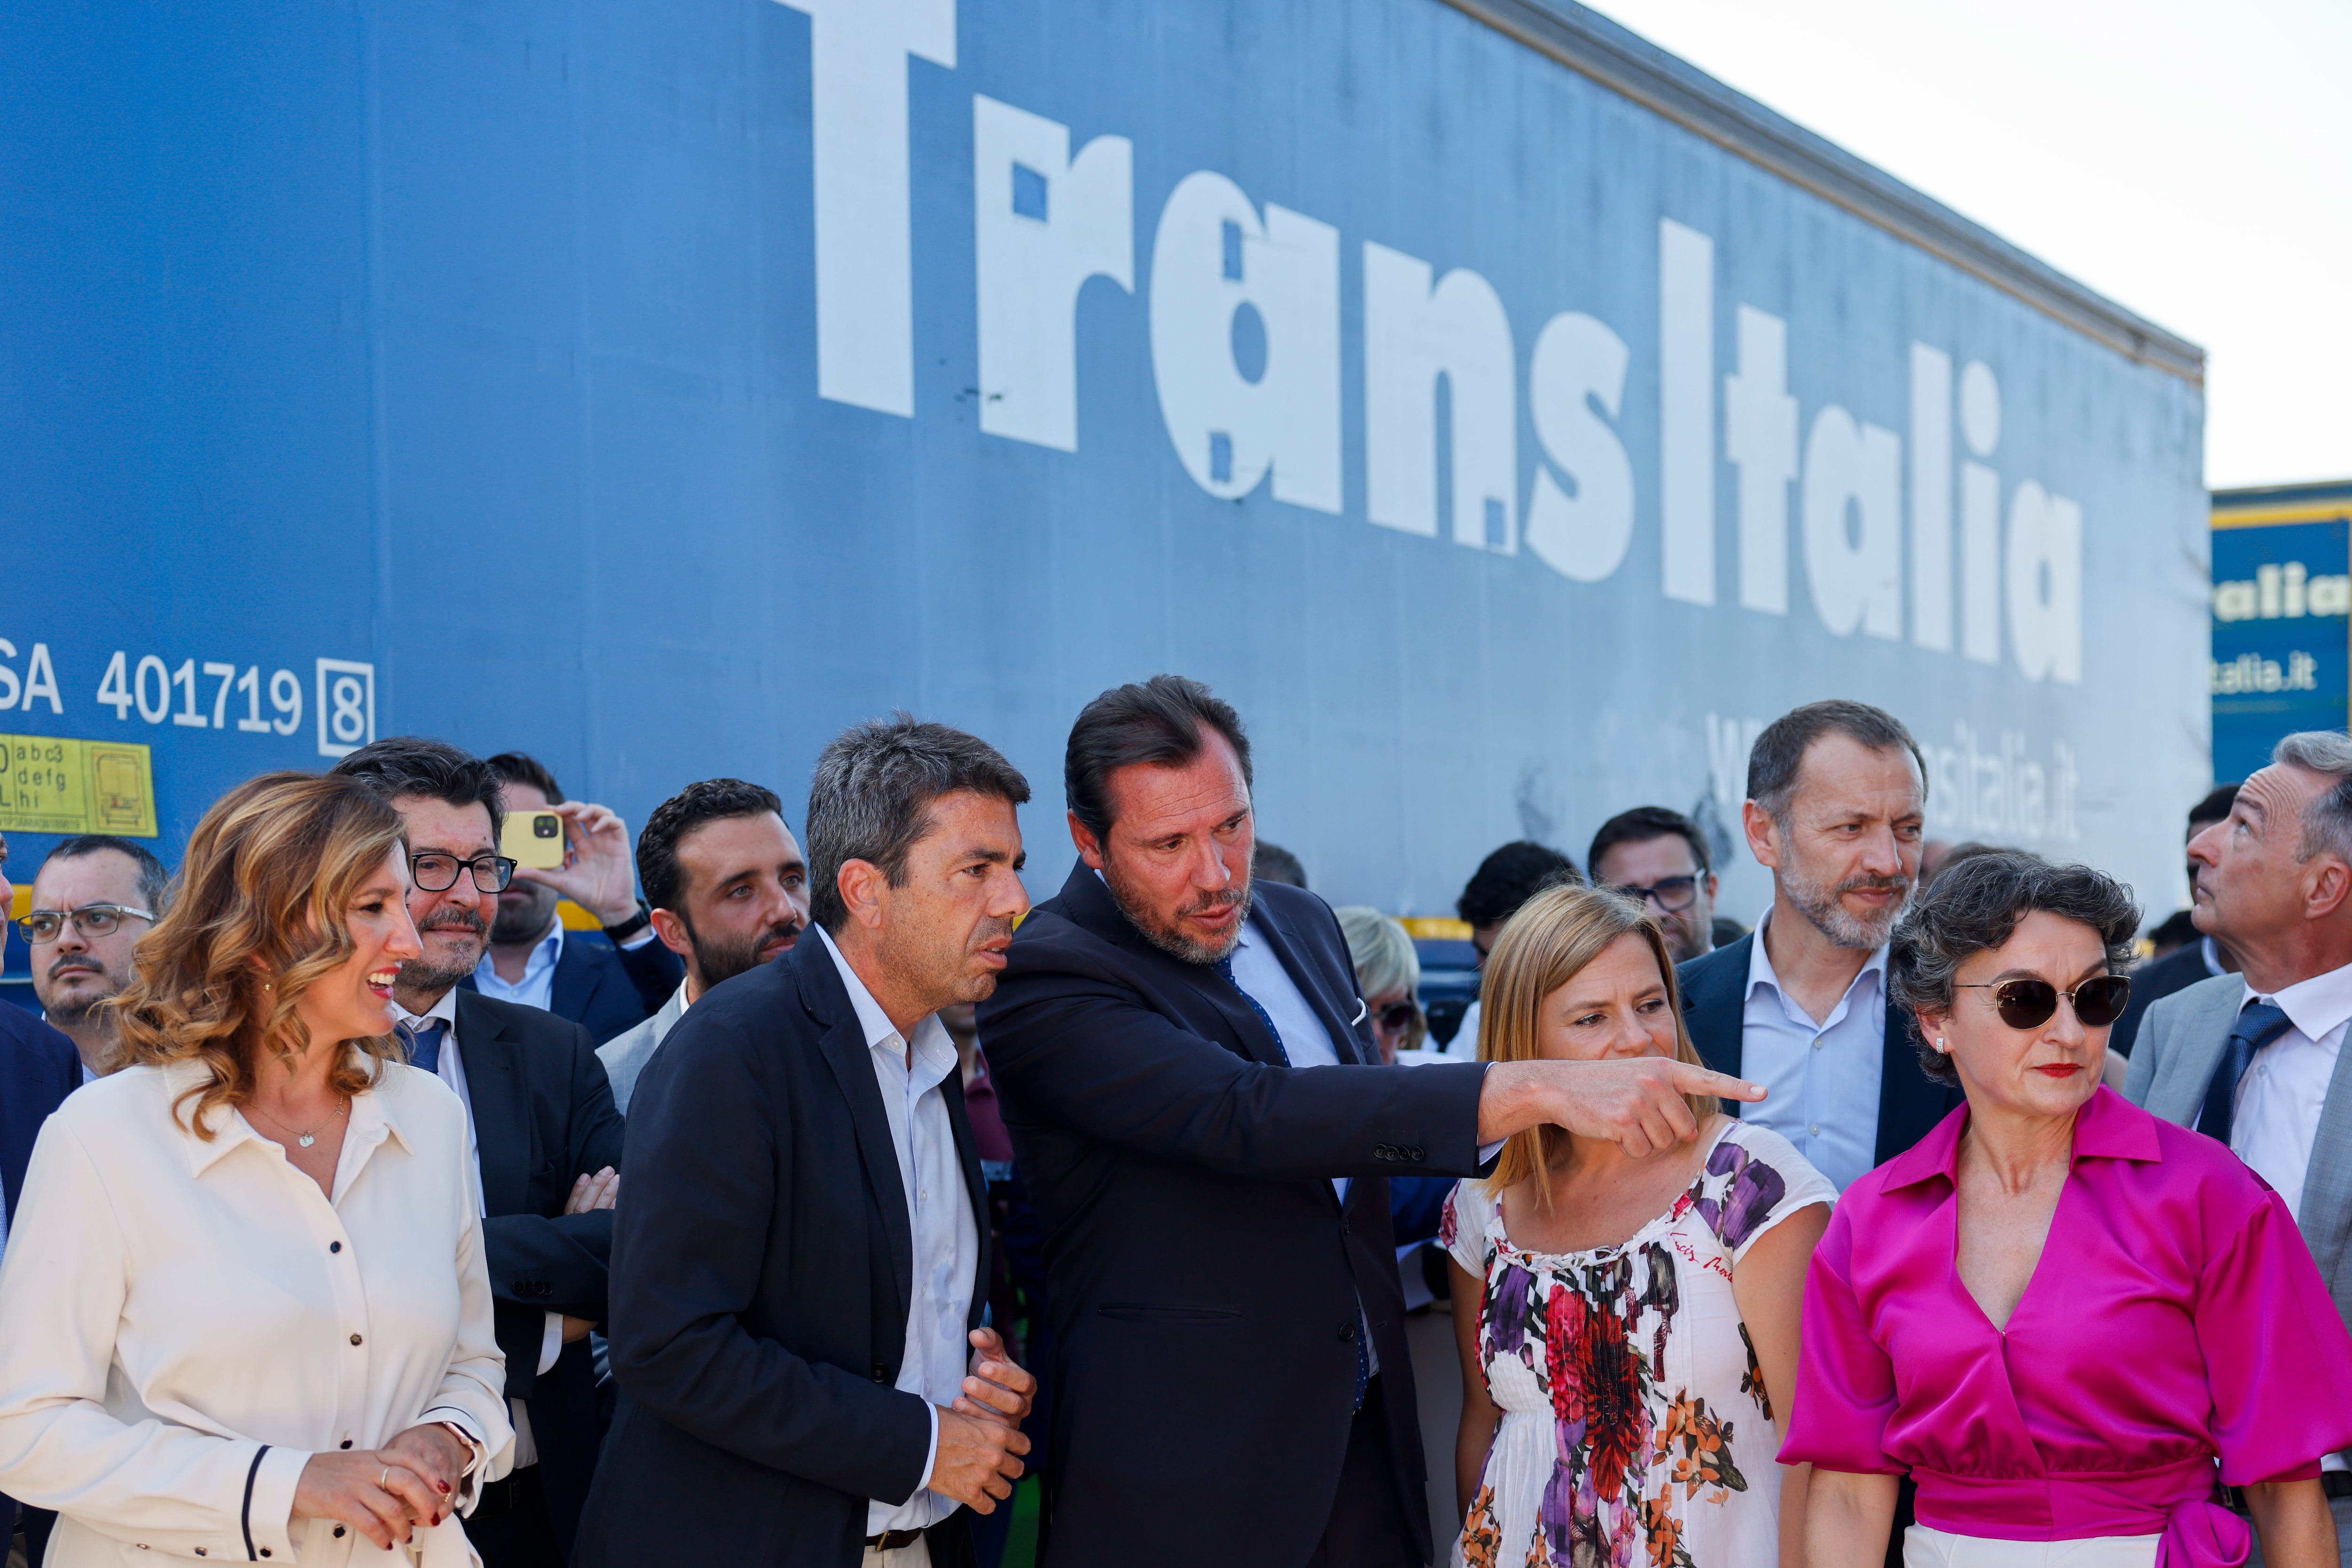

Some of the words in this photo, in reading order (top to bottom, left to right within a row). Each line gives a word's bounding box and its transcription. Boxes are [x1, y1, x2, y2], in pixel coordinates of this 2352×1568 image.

[2212, 561, 2350, 622] alia
[96, 650, 303, 736] 401719
[332, 677, 365, 742] 8
